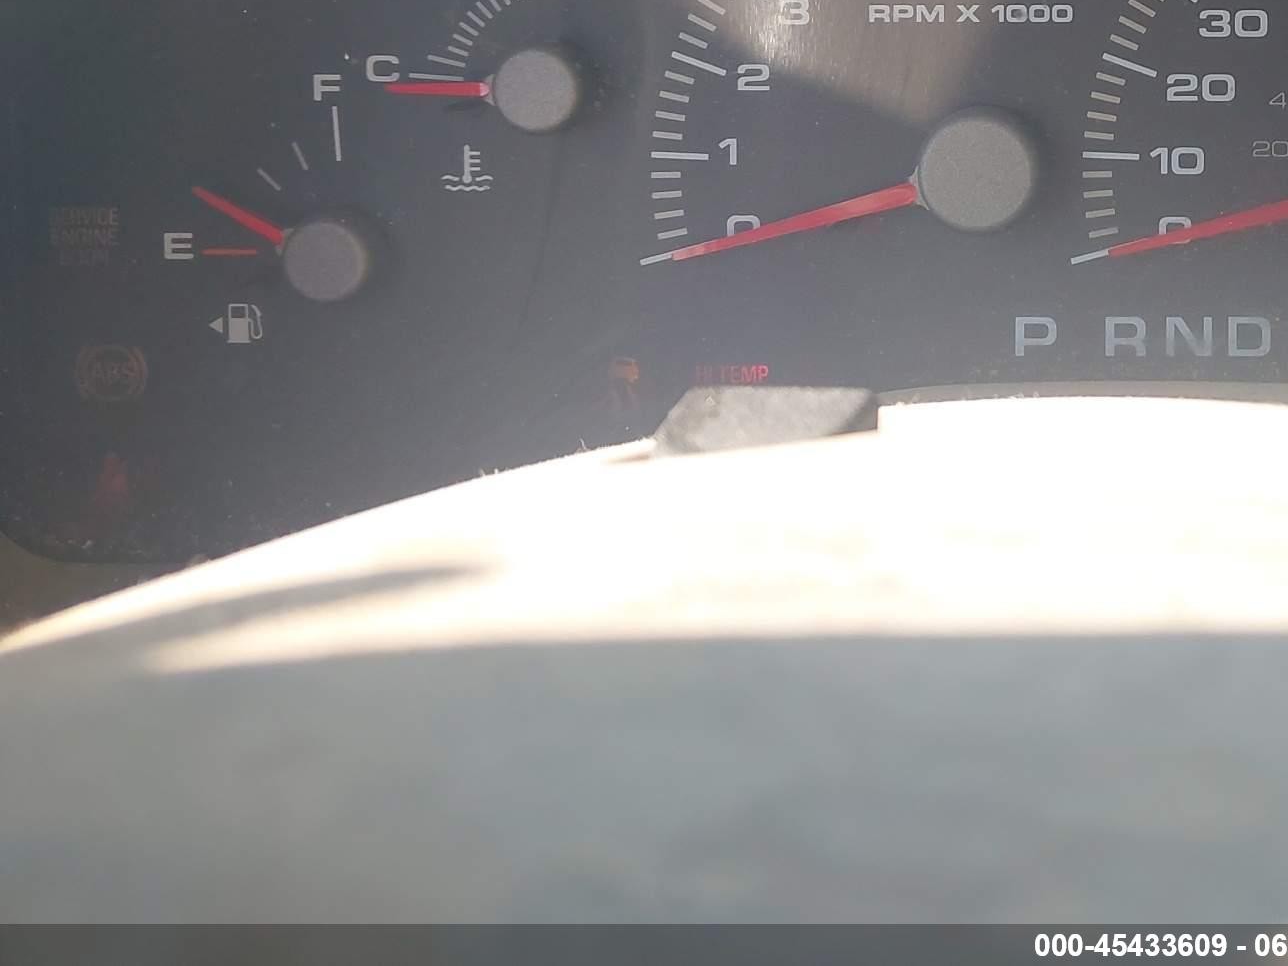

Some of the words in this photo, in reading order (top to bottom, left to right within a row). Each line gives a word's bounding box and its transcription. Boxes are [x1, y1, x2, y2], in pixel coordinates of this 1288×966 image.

[868, 4, 945, 23] RPM
[956, 4, 981, 23] X
[991, 4, 1074, 23] 1000
[1199, 9, 1268, 38] 30
[366, 55, 400, 82] C
[737, 64, 770, 90] 2
[313, 74, 341, 101] F
[1166, 74, 1236, 101] 20
[717, 138, 737, 165] 1
[1150, 147, 1205, 175] 10
[1252, 141, 1288, 157] 20
[164, 233, 194, 259] E
